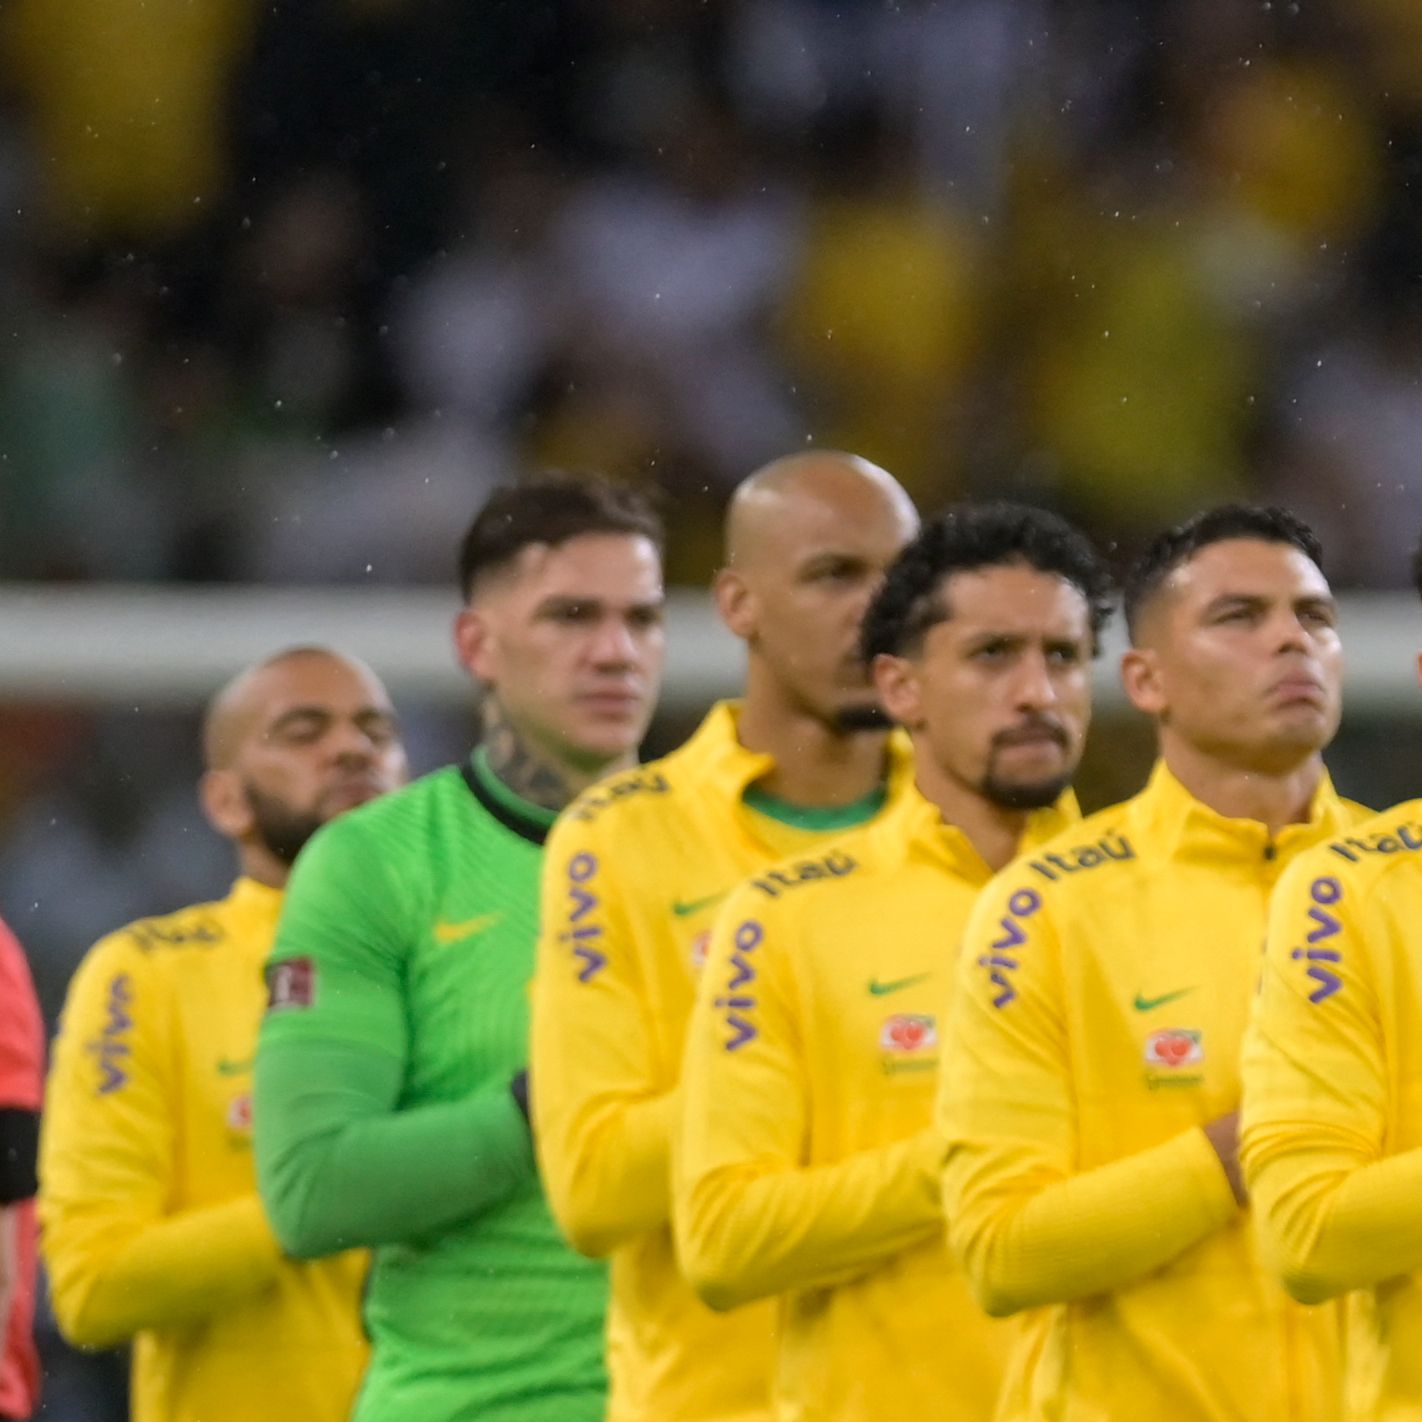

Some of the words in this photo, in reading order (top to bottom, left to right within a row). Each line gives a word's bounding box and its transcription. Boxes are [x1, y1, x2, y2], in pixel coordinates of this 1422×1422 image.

[559, 851, 608, 985] vivo
[976, 886, 1043, 1010] vivo
[1291, 875, 1343, 1005] vivo
[714, 918, 764, 1052] vivo
